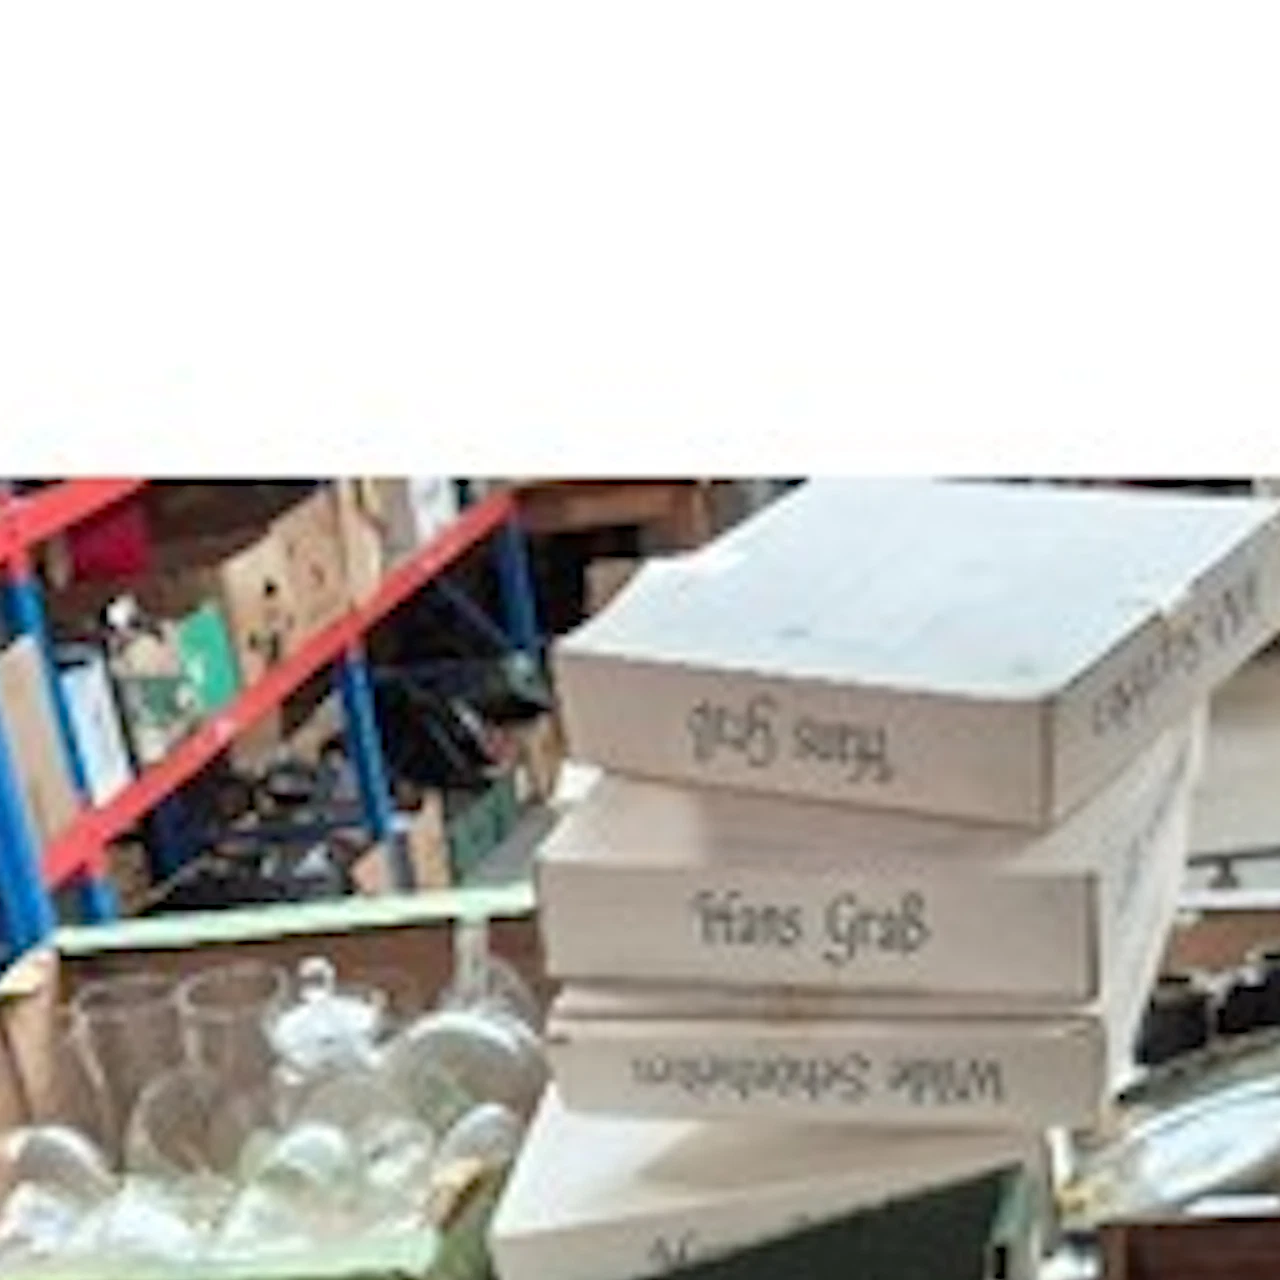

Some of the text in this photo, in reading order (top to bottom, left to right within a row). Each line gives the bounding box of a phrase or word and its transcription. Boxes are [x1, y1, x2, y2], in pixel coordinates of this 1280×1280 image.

[793, 716, 893, 783] Hans
[688, 889, 930, 967] Hans Graß
